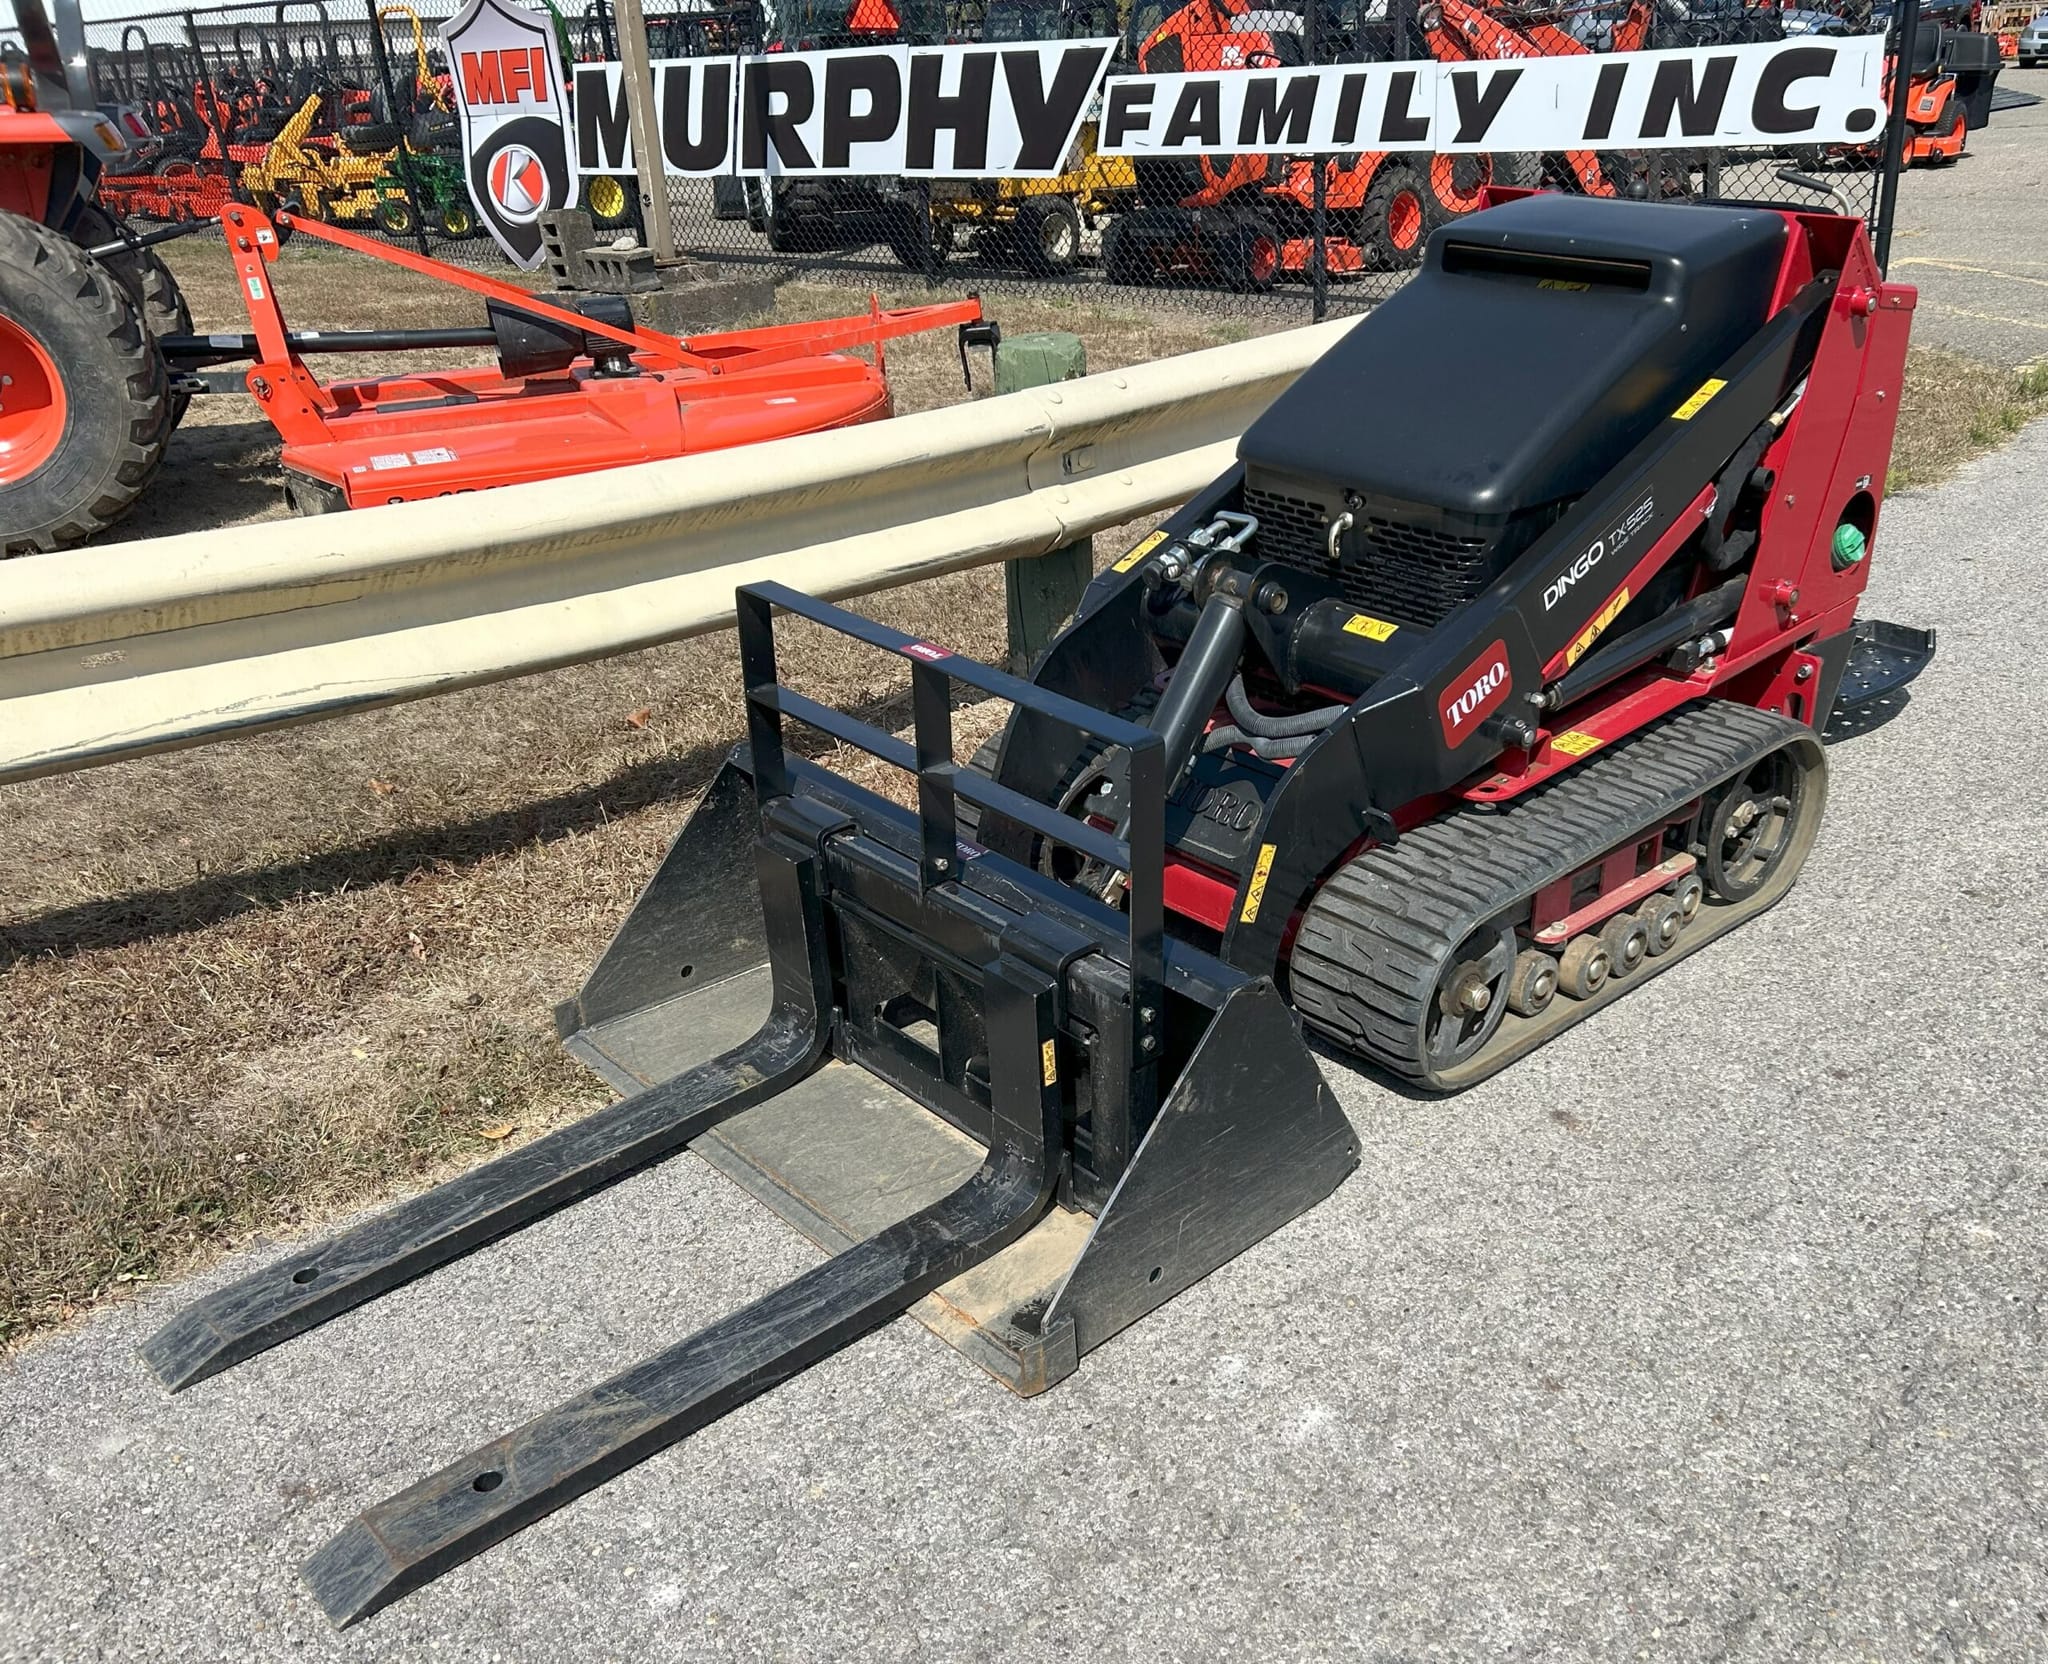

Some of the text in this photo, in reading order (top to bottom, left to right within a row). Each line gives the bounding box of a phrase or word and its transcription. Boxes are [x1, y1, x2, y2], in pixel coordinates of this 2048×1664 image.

[460, 46, 549, 106] MFI
[576, 46, 1877, 171] MURPHY FAMILY INC.
[1543, 540, 1604, 611] DINGO
[1446, 661, 1506, 729] TORO
